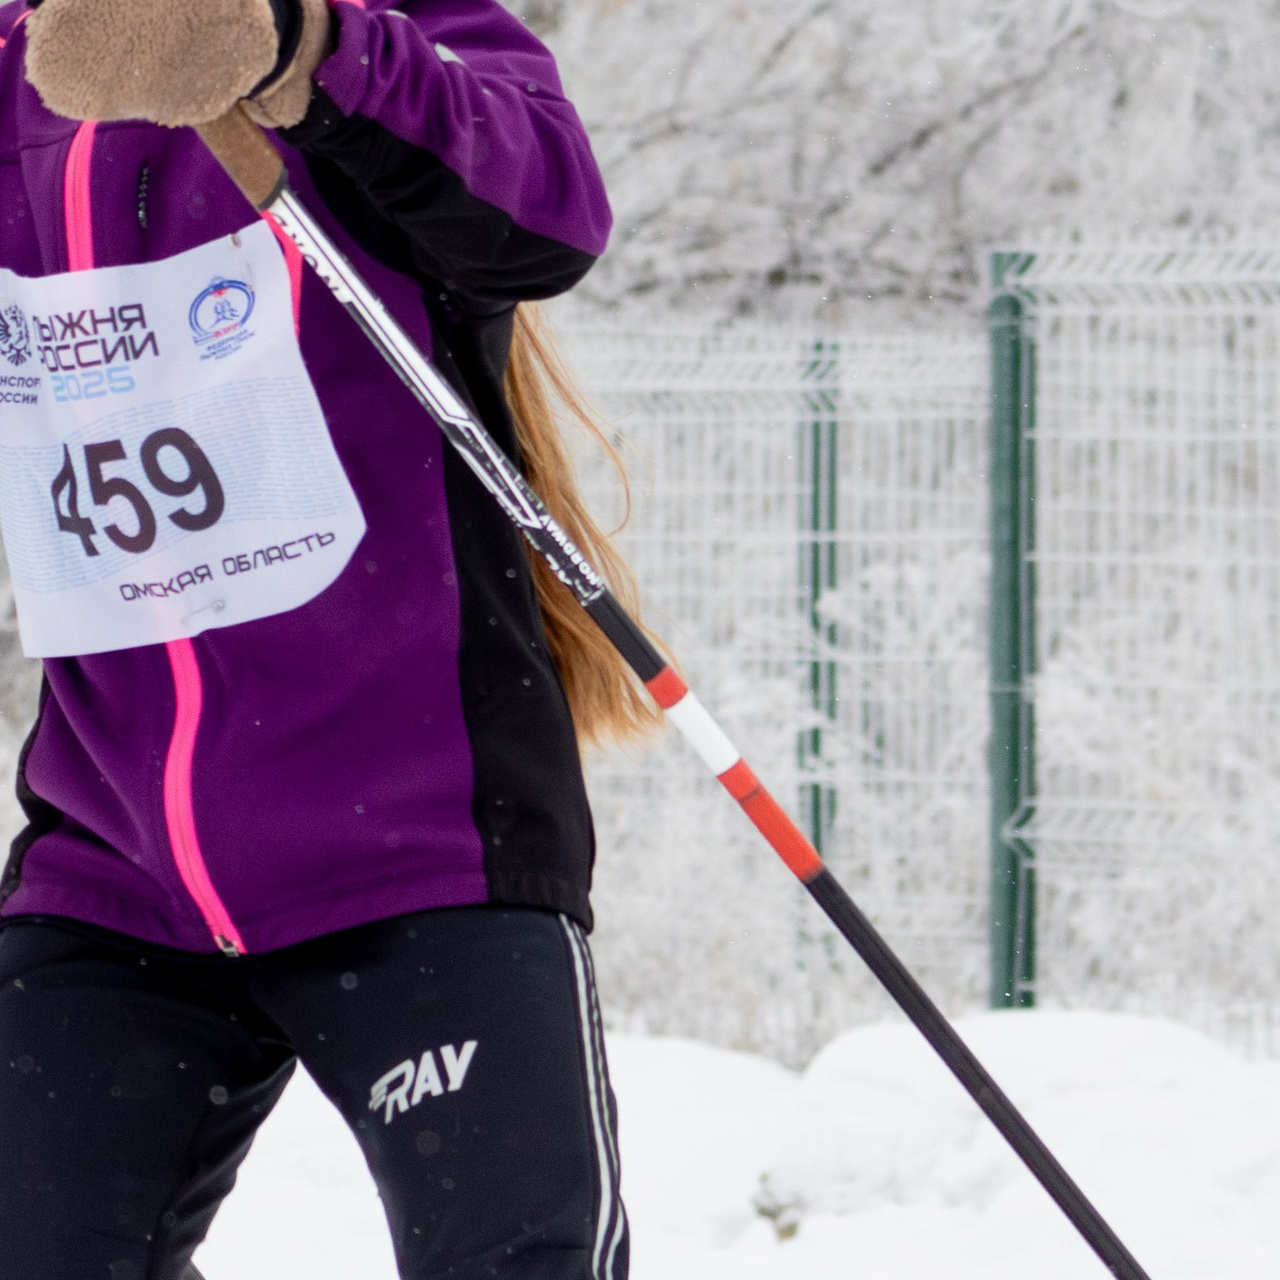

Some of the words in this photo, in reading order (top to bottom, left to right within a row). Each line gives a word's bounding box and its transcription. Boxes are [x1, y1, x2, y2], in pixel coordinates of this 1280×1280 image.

[32, 303, 147, 343] ЫЖНЯ
[50, 365, 135, 402] 2025
[51, 427, 225, 557] 459
[120, 564, 214, 601] ОМСКАЯ
[222, 532, 336, 576] ОБЛАСТЬ
[368, 1039, 478, 1125] RAY
